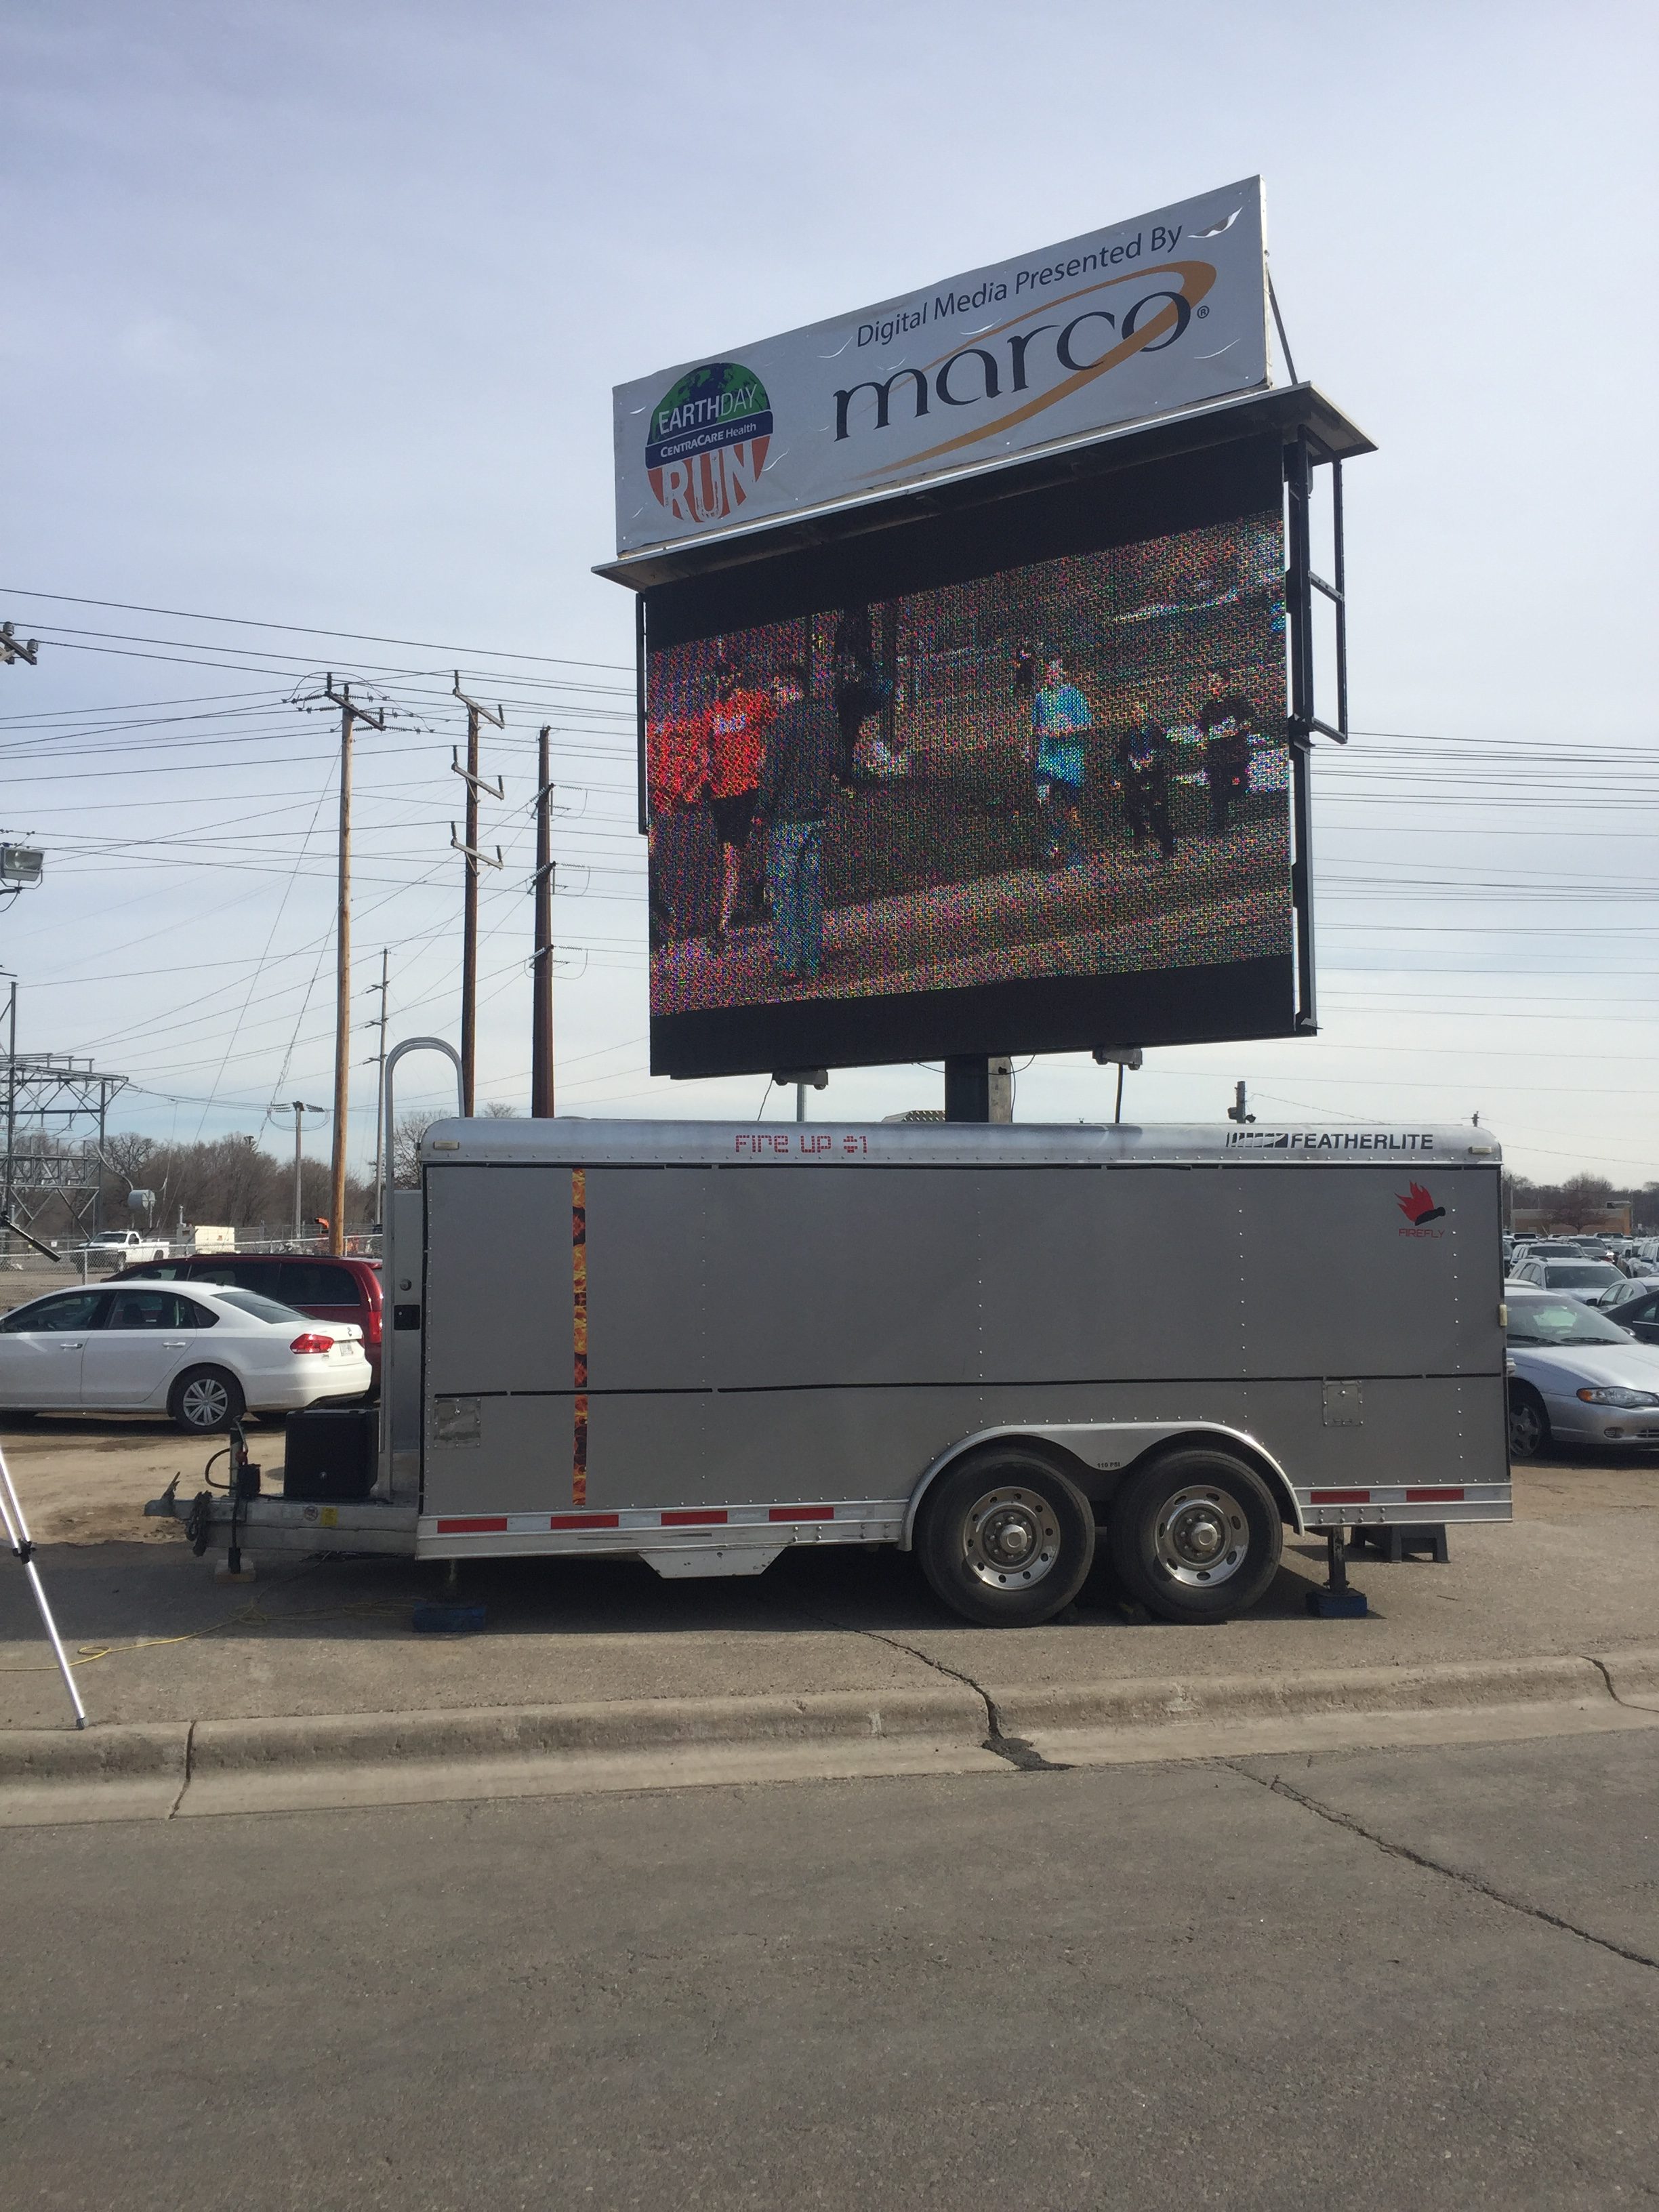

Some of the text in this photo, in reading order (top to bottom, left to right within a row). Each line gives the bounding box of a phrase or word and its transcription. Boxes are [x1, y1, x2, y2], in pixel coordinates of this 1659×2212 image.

[857, 225, 1183, 348] Digital Media Presented By
[725, 422, 757, 438] Health
[662, 439, 756, 522] RUN
[1290, 1133, 1433, 1150] FEATHERLITE
[1398, 1228, 1445, 1238] FIREFLY
